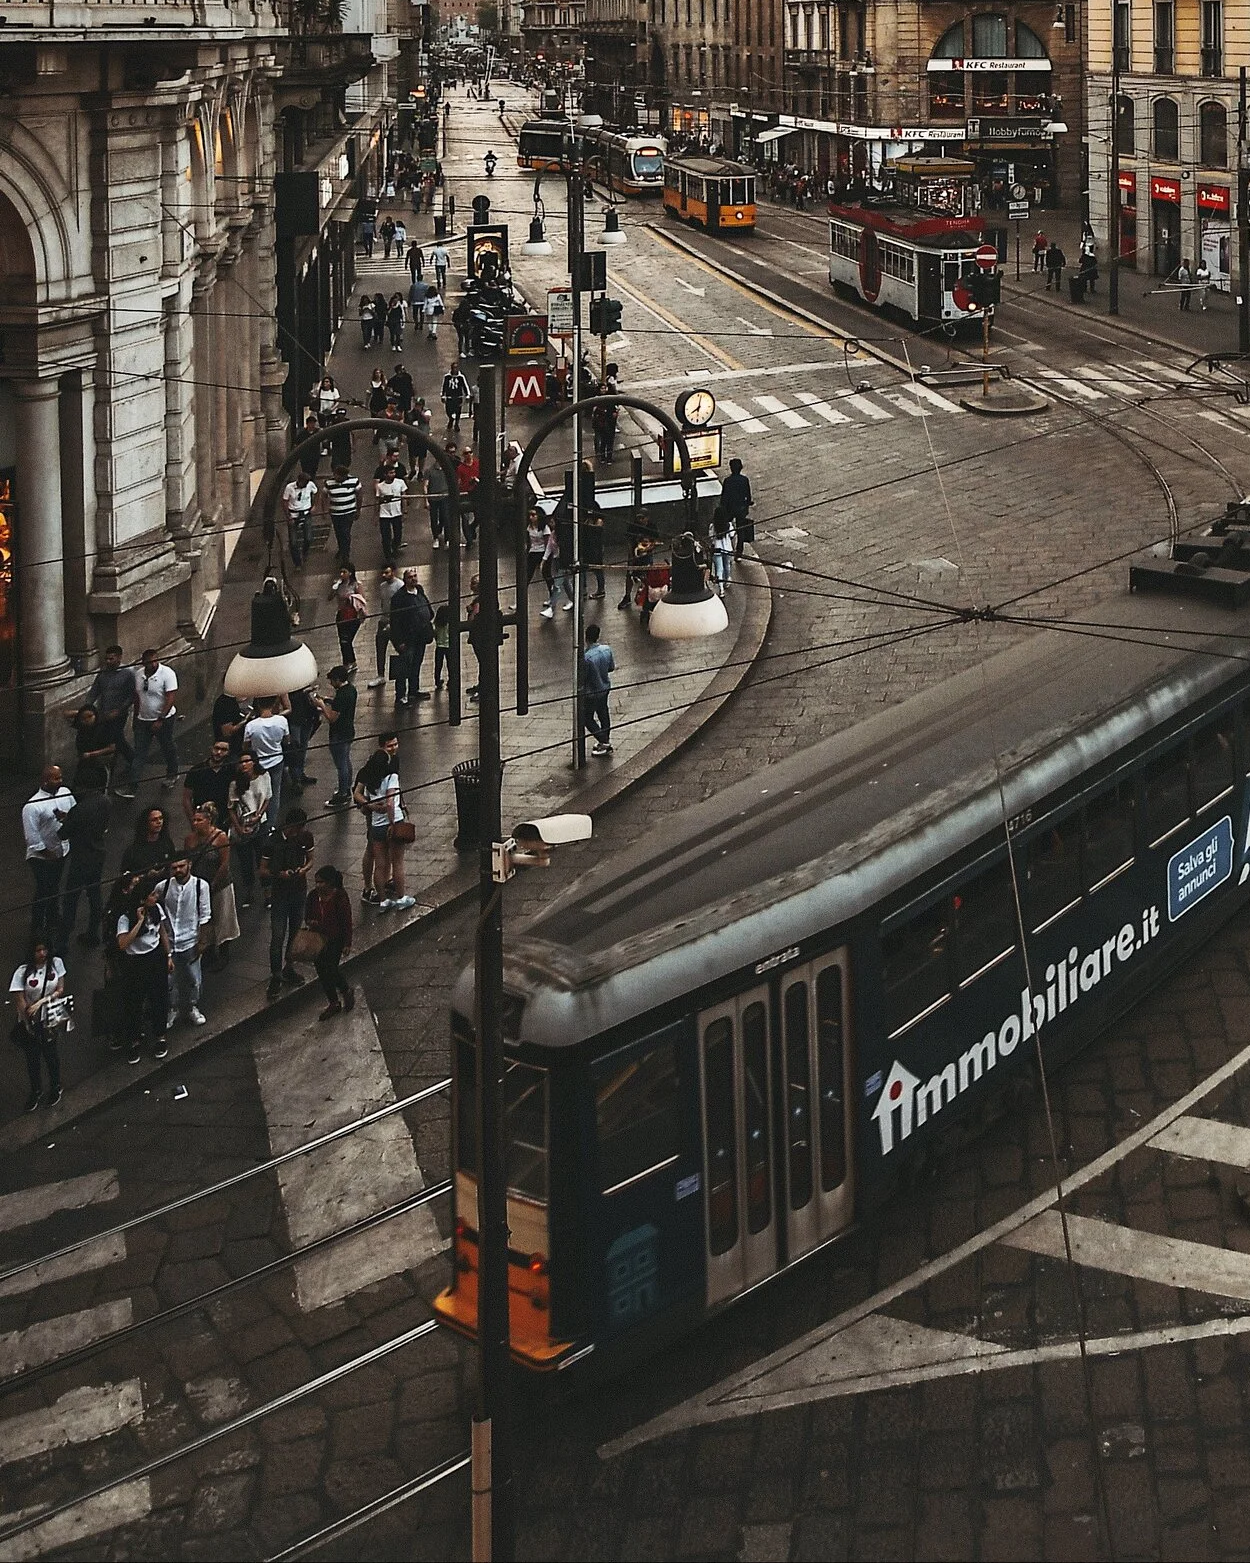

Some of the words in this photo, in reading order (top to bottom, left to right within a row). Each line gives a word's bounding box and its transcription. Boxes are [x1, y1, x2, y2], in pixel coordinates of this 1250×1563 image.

[966, 61, 988, 69] KFC
[989, 61, 1026, 69] Restaurant
[904, 130, 927, 138] KFC
[928, 130, 964, 138] Restaurant
[509, 375, 542, 399] M
[1177, 851, 1205, 881] Salva
[1205, 835, 1219, 862] gli
[1177, 858, 1217, 902] annunci
